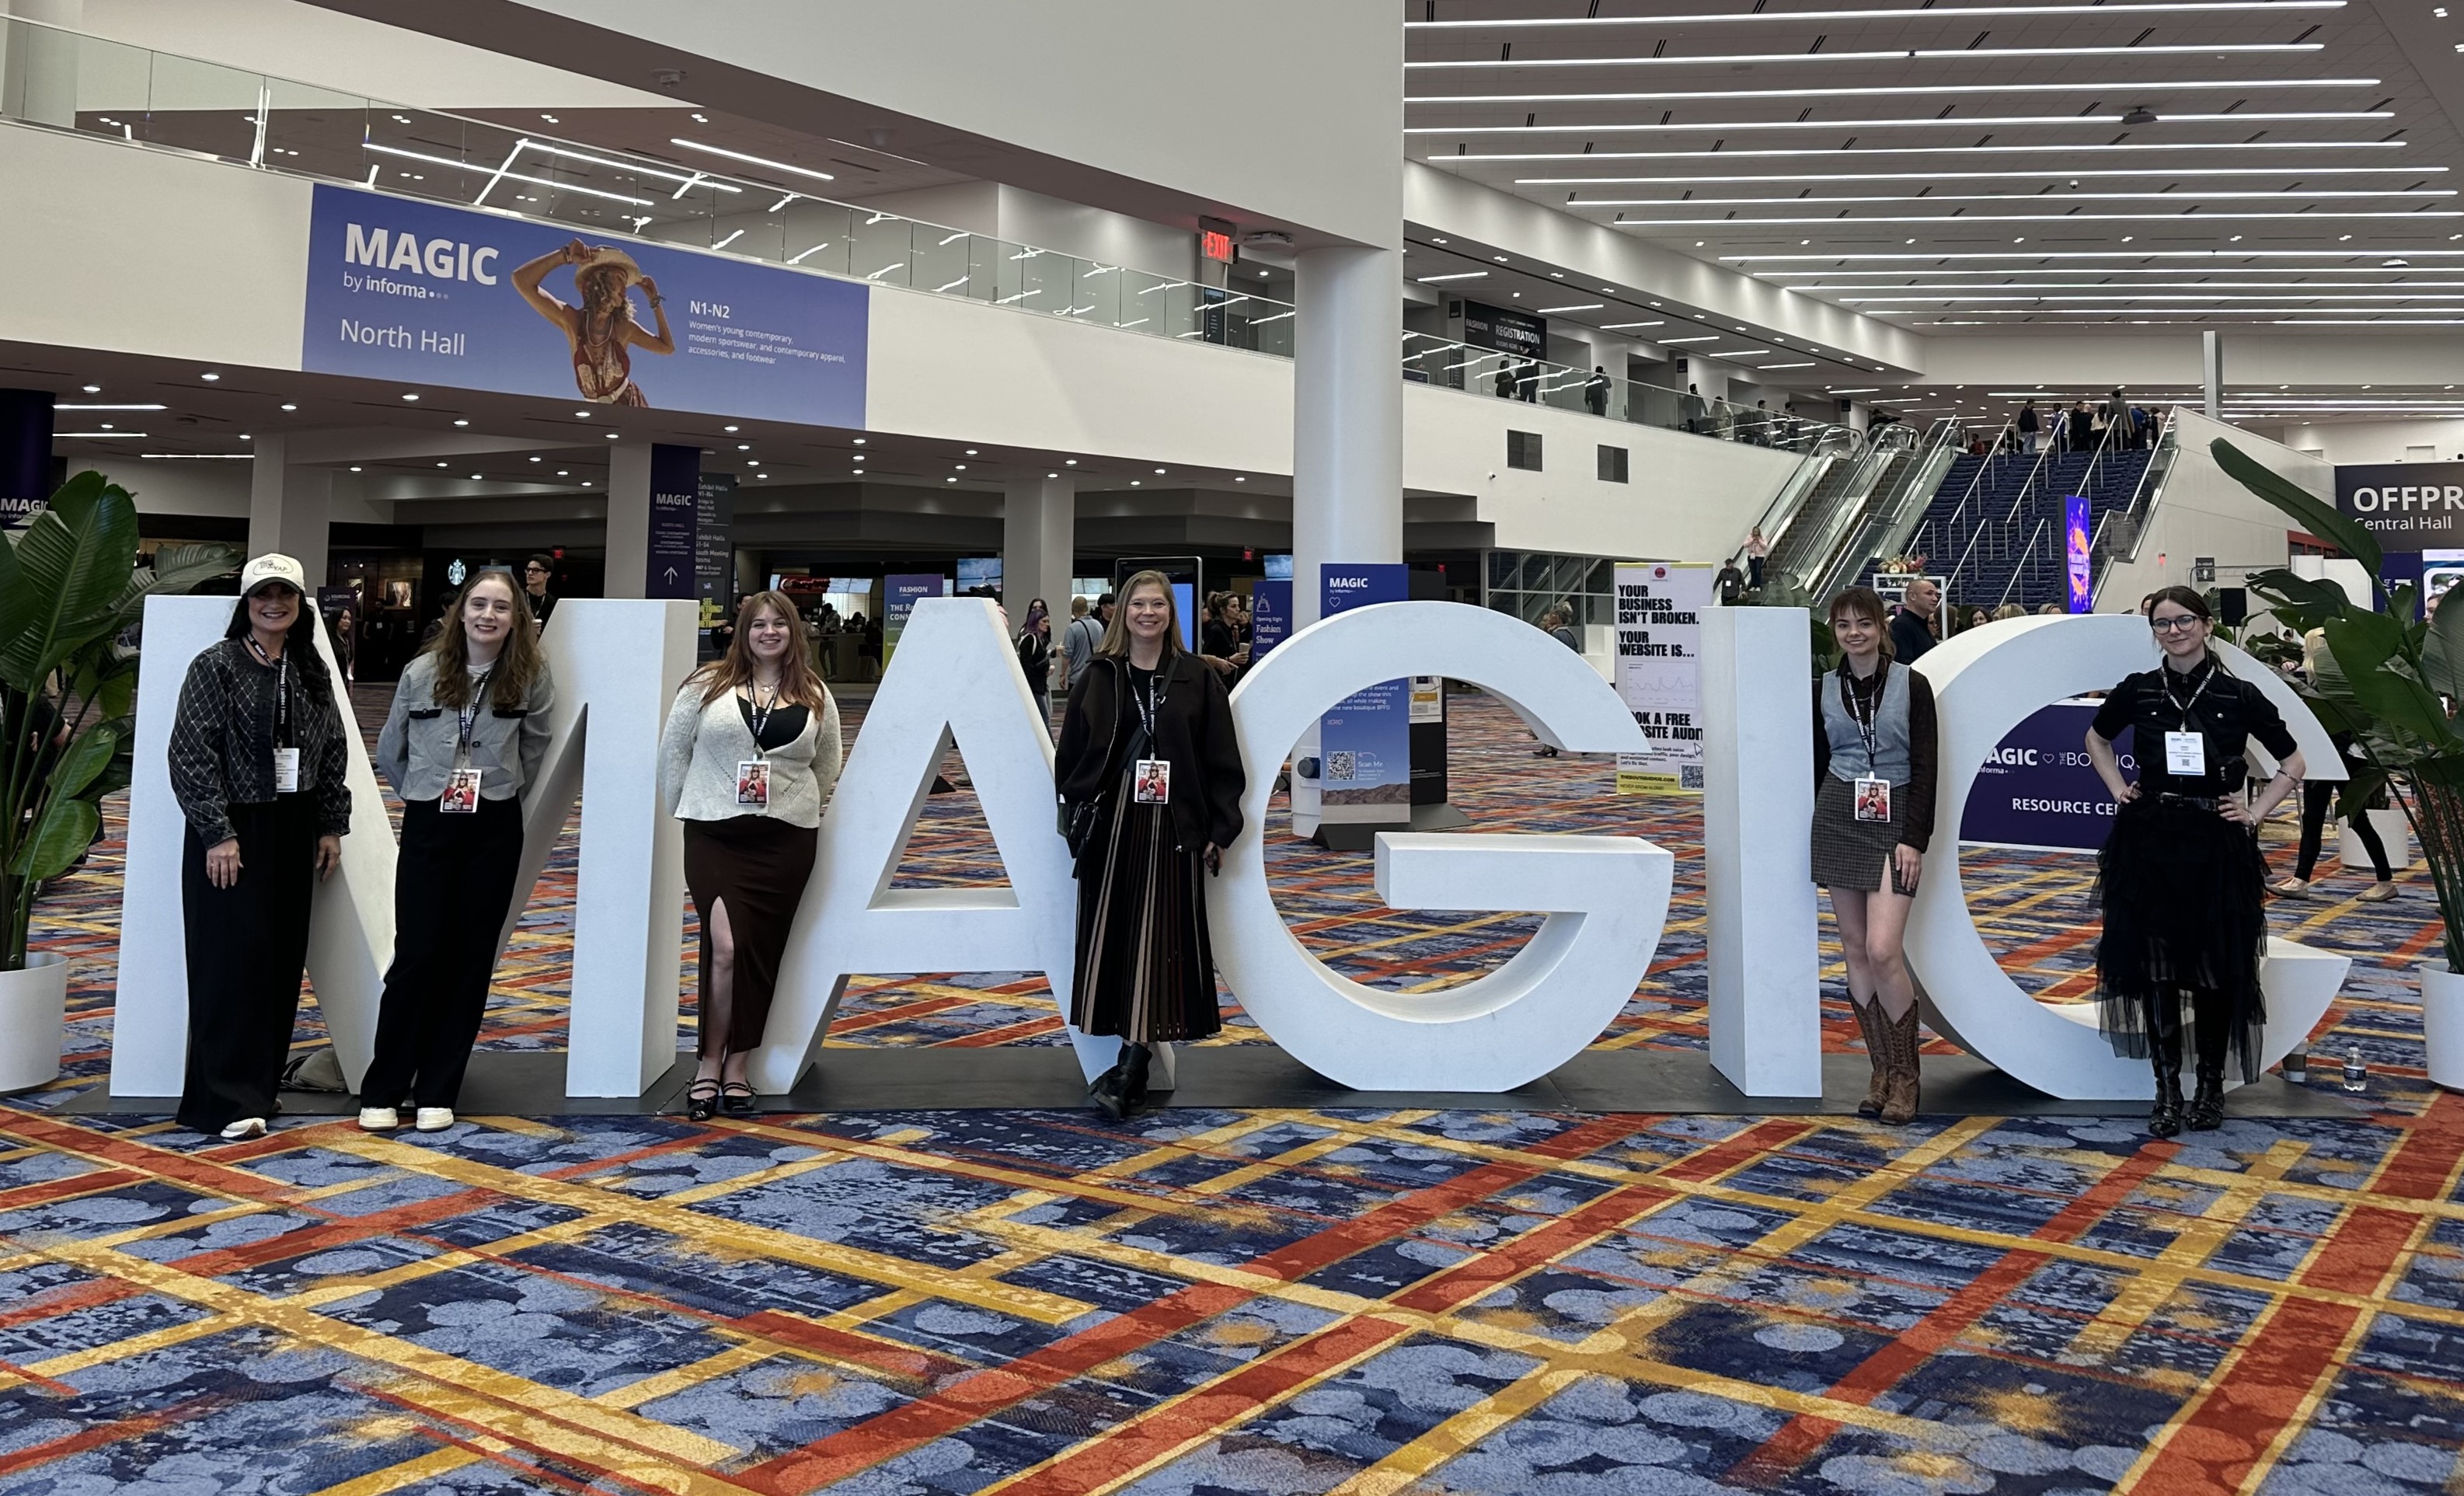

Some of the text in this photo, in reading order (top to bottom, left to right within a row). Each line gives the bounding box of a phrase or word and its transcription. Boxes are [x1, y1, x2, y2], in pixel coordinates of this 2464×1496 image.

[345, 223, 499, 285] MAGIC
[1208, 232, 1229, 260] EXIT
[343, 271, 427, 298] by informa
[690, 300, 730, 319] N1-N2
[689, 320, 793, 344] Women's young contemporary,
[1466, 318, 1488, 331] FASHION
[341, 319, 465, 356] North Hall
[1496, 325, 1540, 344] REGISTRATION
[688, 333, 716, 344] modern
[759, 343, 773, 352] and
[774, 347, 819, 361] contemporary
[688, 346, 776, 364] accessories, and footwear
[657, 493, 692, 506] MAGIC
[2354, 485, 2464, 511] OFFPR
[2420, 515, 2452, 529] Hall
[1330, 577, 1368, 588] MAGIC
[1619, 584, 1649, 598] YOUR
[1619, 598, 1672, 611] BUSINESS
[1619, 612, 1699, 625] ISN'T BROKEN.
[1256, 624, 1281, 633] Fashion
[1256, 635, 1274, 644] Show
[1619, 631, 1649, 643] YOUR
[1619, 643, 1695, 657] WEBSITE IS...
[1631, 711, 1691, 726] OK A FREE
[1640, 726, 1668, 739] SITE
[1985, 748, 2037, 765] AGIC
[2012, 797, 2091, 814] RESOURCE
[110, 595, 2352, 1099] MAGIC
